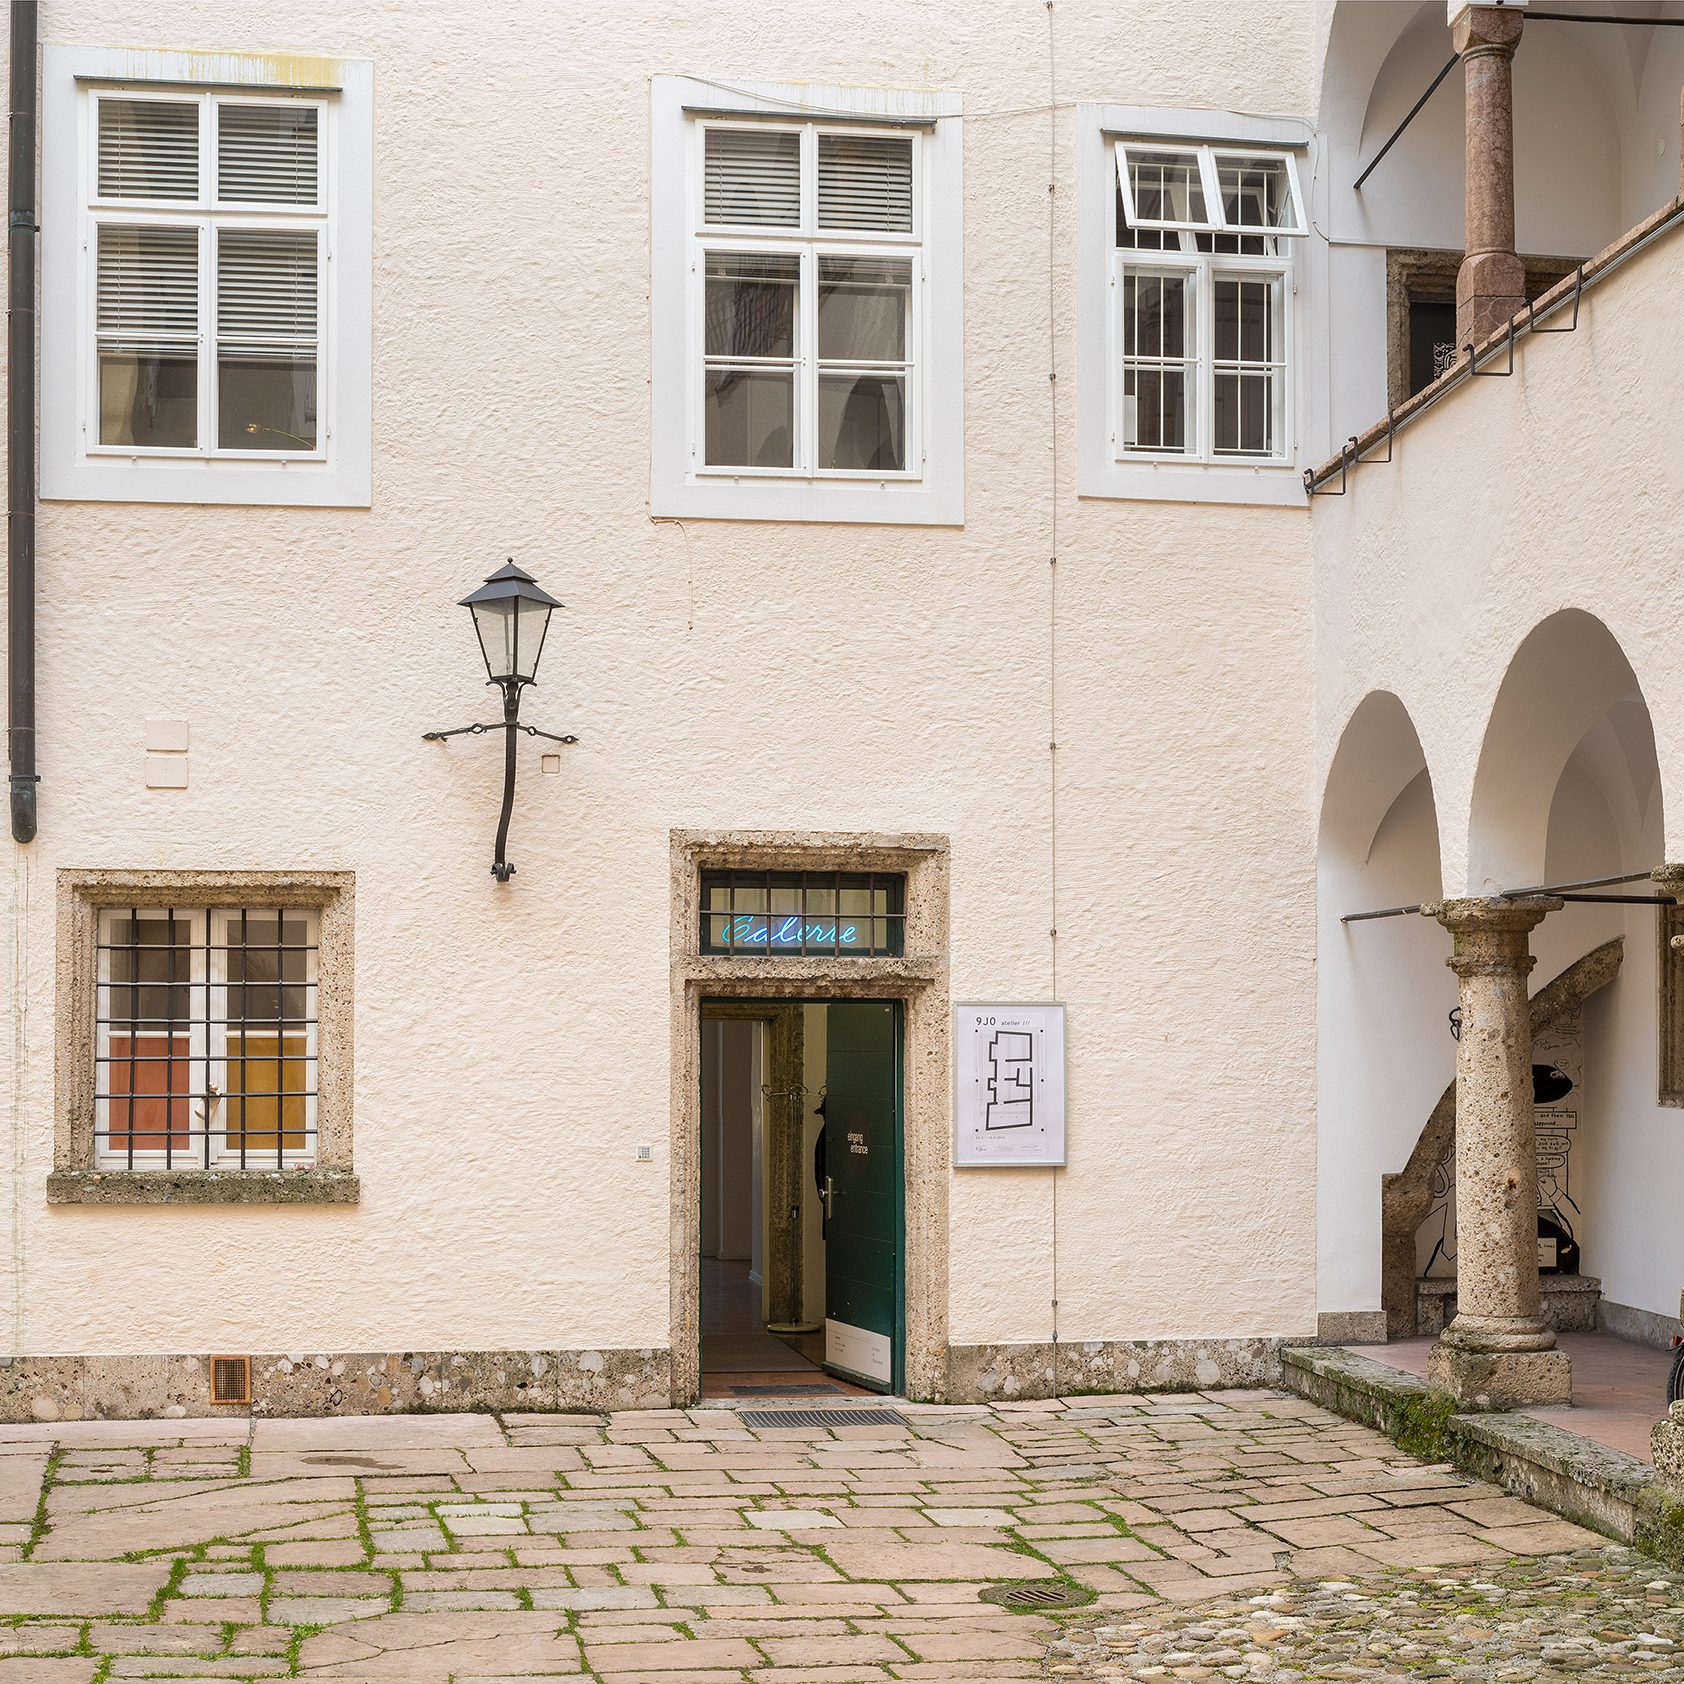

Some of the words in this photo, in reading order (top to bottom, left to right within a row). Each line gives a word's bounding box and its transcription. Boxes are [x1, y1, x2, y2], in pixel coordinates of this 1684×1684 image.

[721, 914, 858, 944] Galerie
[847, 1131, 863, 1144] eingang
[850, 1144, 868, 1154] entrance
